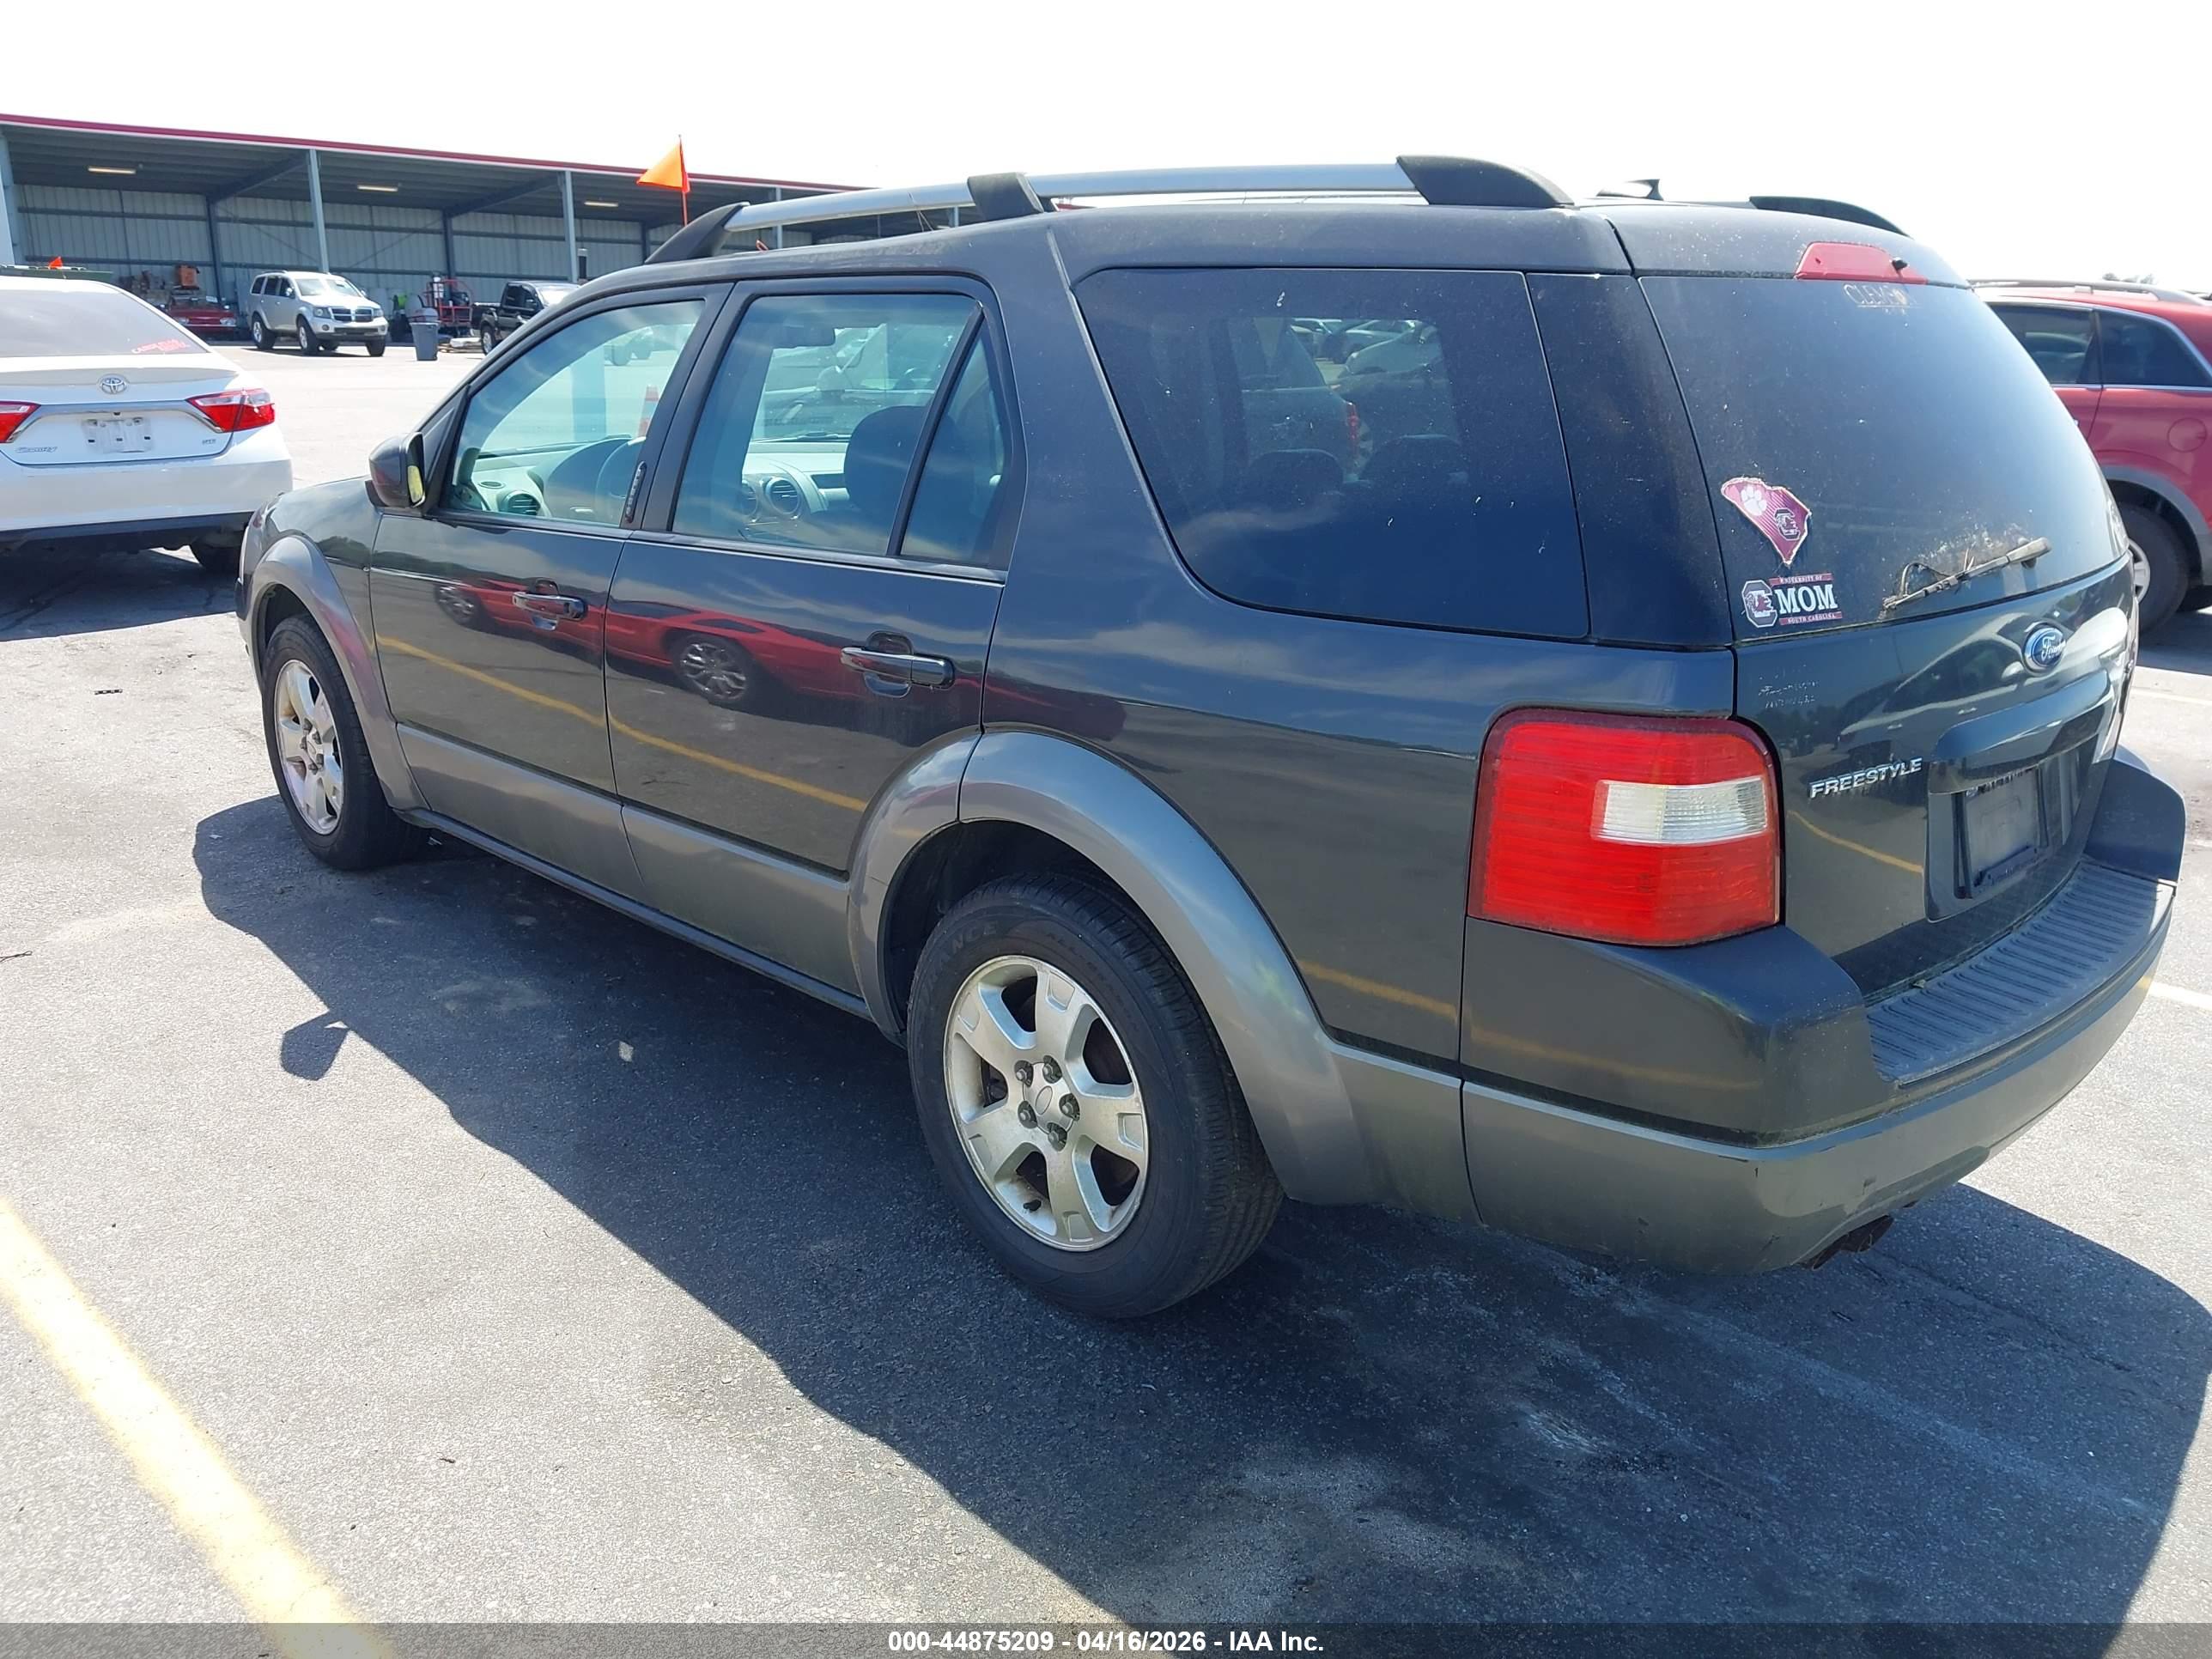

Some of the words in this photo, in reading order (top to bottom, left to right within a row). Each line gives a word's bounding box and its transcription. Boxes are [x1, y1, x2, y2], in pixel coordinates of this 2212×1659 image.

[1774, 584, 1838, 615] MOM
[1787, 616, 1807, 625] SOUTH
[1808, 613, 1837, 623] CAROLINA
[1809, 757, 1923, 799] FREESTYLE
